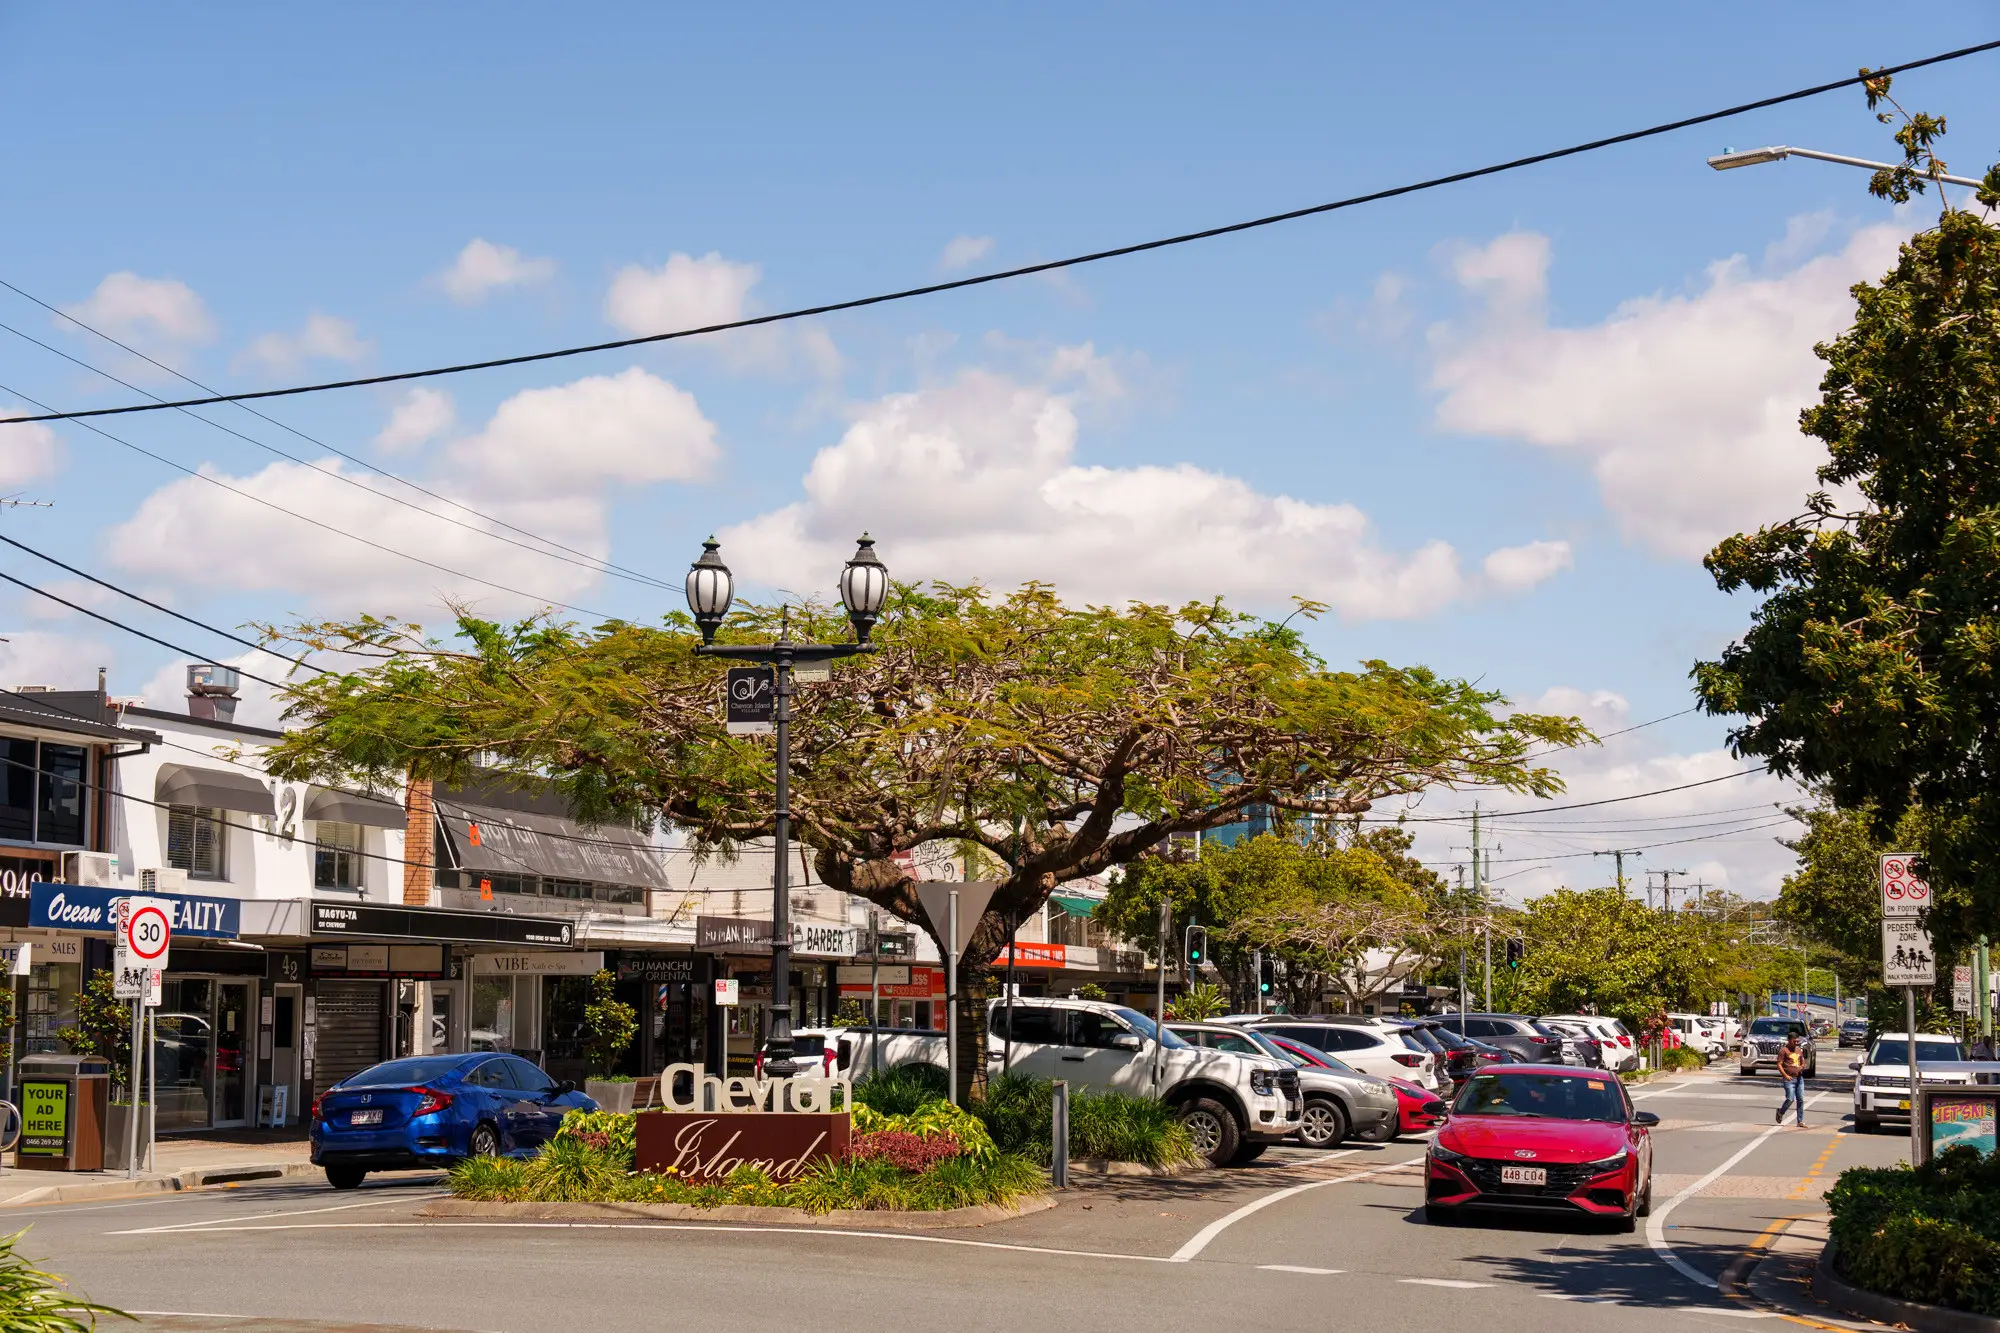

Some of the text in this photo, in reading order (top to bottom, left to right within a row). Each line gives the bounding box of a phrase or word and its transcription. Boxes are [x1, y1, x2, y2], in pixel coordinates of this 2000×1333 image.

[48, 892, 102, 923] Ocean
[170, 899, 226, 931] EALTY
[318, 908, 357, 920] WAGYU-YA
[139, 922, 160, 942] 30
[1899, 933, 1917, 941] ZONE
[807, 927, 843, 952] BARBER
[52, 942, 76, 954] SALES
[282, 954, 298, 980] 42
[494, 957, 529, 970] VIBE
[555, 963, 566, 971] Spa
[632, 961, 693, 971] FU MANCHU
[646, 971, 693, 981] ORIENTAL
[893, 986, 928, 996] FOOD STORE
[660, 1062, 852, 1113] Chevron
[27, 1089, 63, 1100] YOUR
[36, 1105, 53, 1115] AD
[1935, 1104, 1959, 1124] JET
[1961, 1103, 1985, 1120] SKI
[28, 1120, 62, 1131] HERE
[663, 1118, 828, 1179] Island
[1503, 1170, 1520, 1180] 448
